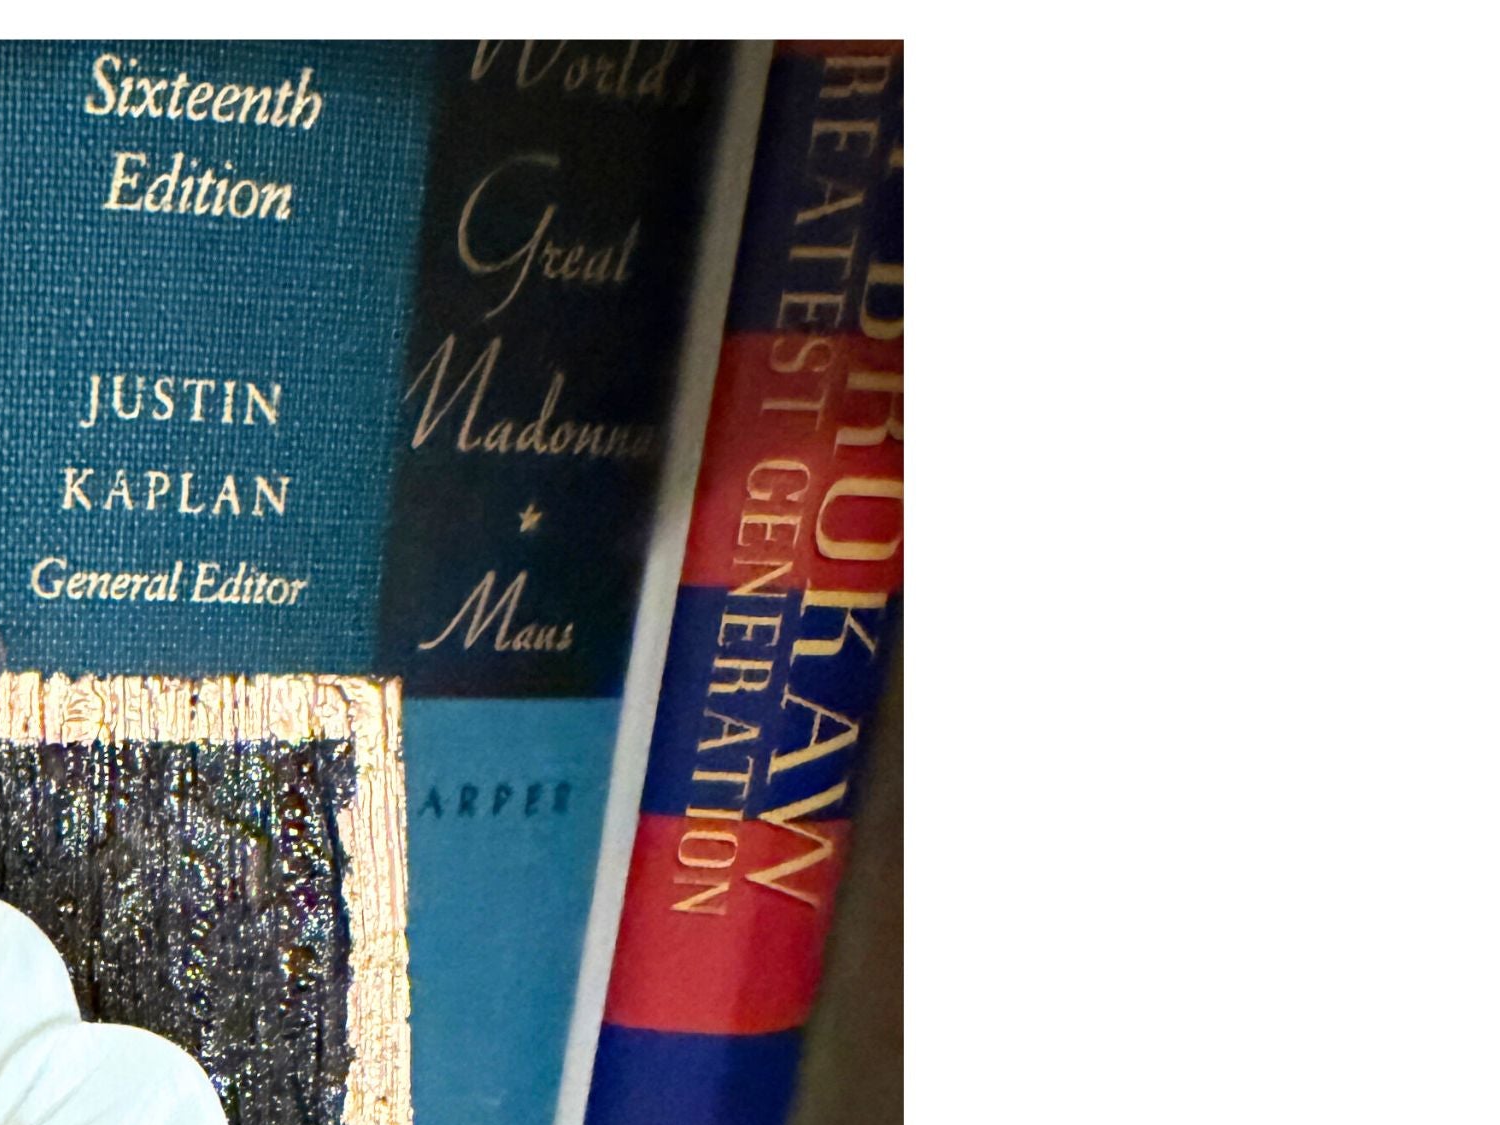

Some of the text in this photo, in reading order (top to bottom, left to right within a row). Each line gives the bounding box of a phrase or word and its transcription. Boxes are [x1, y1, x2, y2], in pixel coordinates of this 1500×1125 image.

[84, 52, 324, 131] Sixteenth
[104, 151, 295, 221] Edition
[457, 153, 642, 319] Great
[78, 373, 283, 429] JUSTIN
[61, 466, 290, 517] KAPLAN
[670, 54, 892, 916] REATEST GENERATION
[30, 555, 310, 606] General Editor
